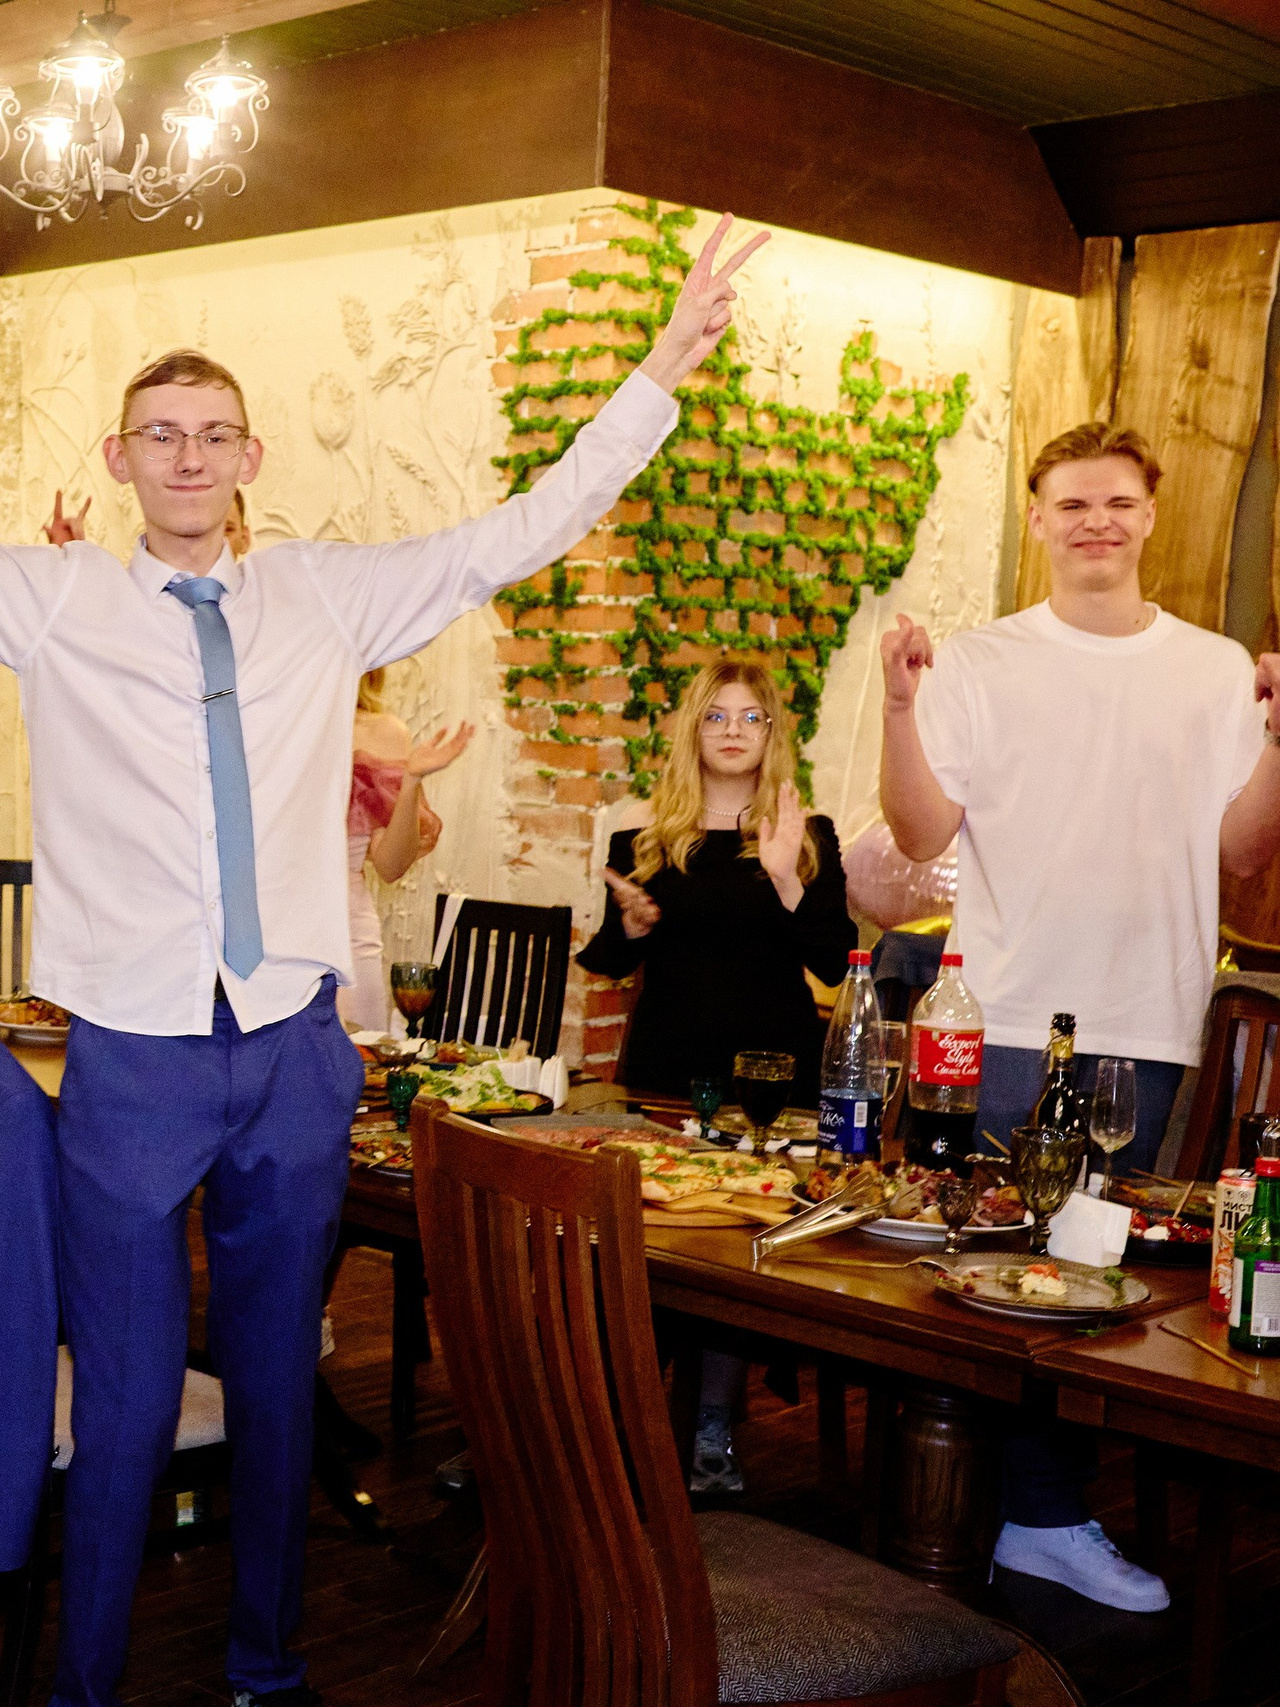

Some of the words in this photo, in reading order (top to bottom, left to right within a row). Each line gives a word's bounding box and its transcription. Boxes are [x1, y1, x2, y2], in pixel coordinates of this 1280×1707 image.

[938, 1033, 982, 1056] Export
[943, 1049, 976, 1067] Style
[1223, 1201, 1253, 1212] МИСТ
